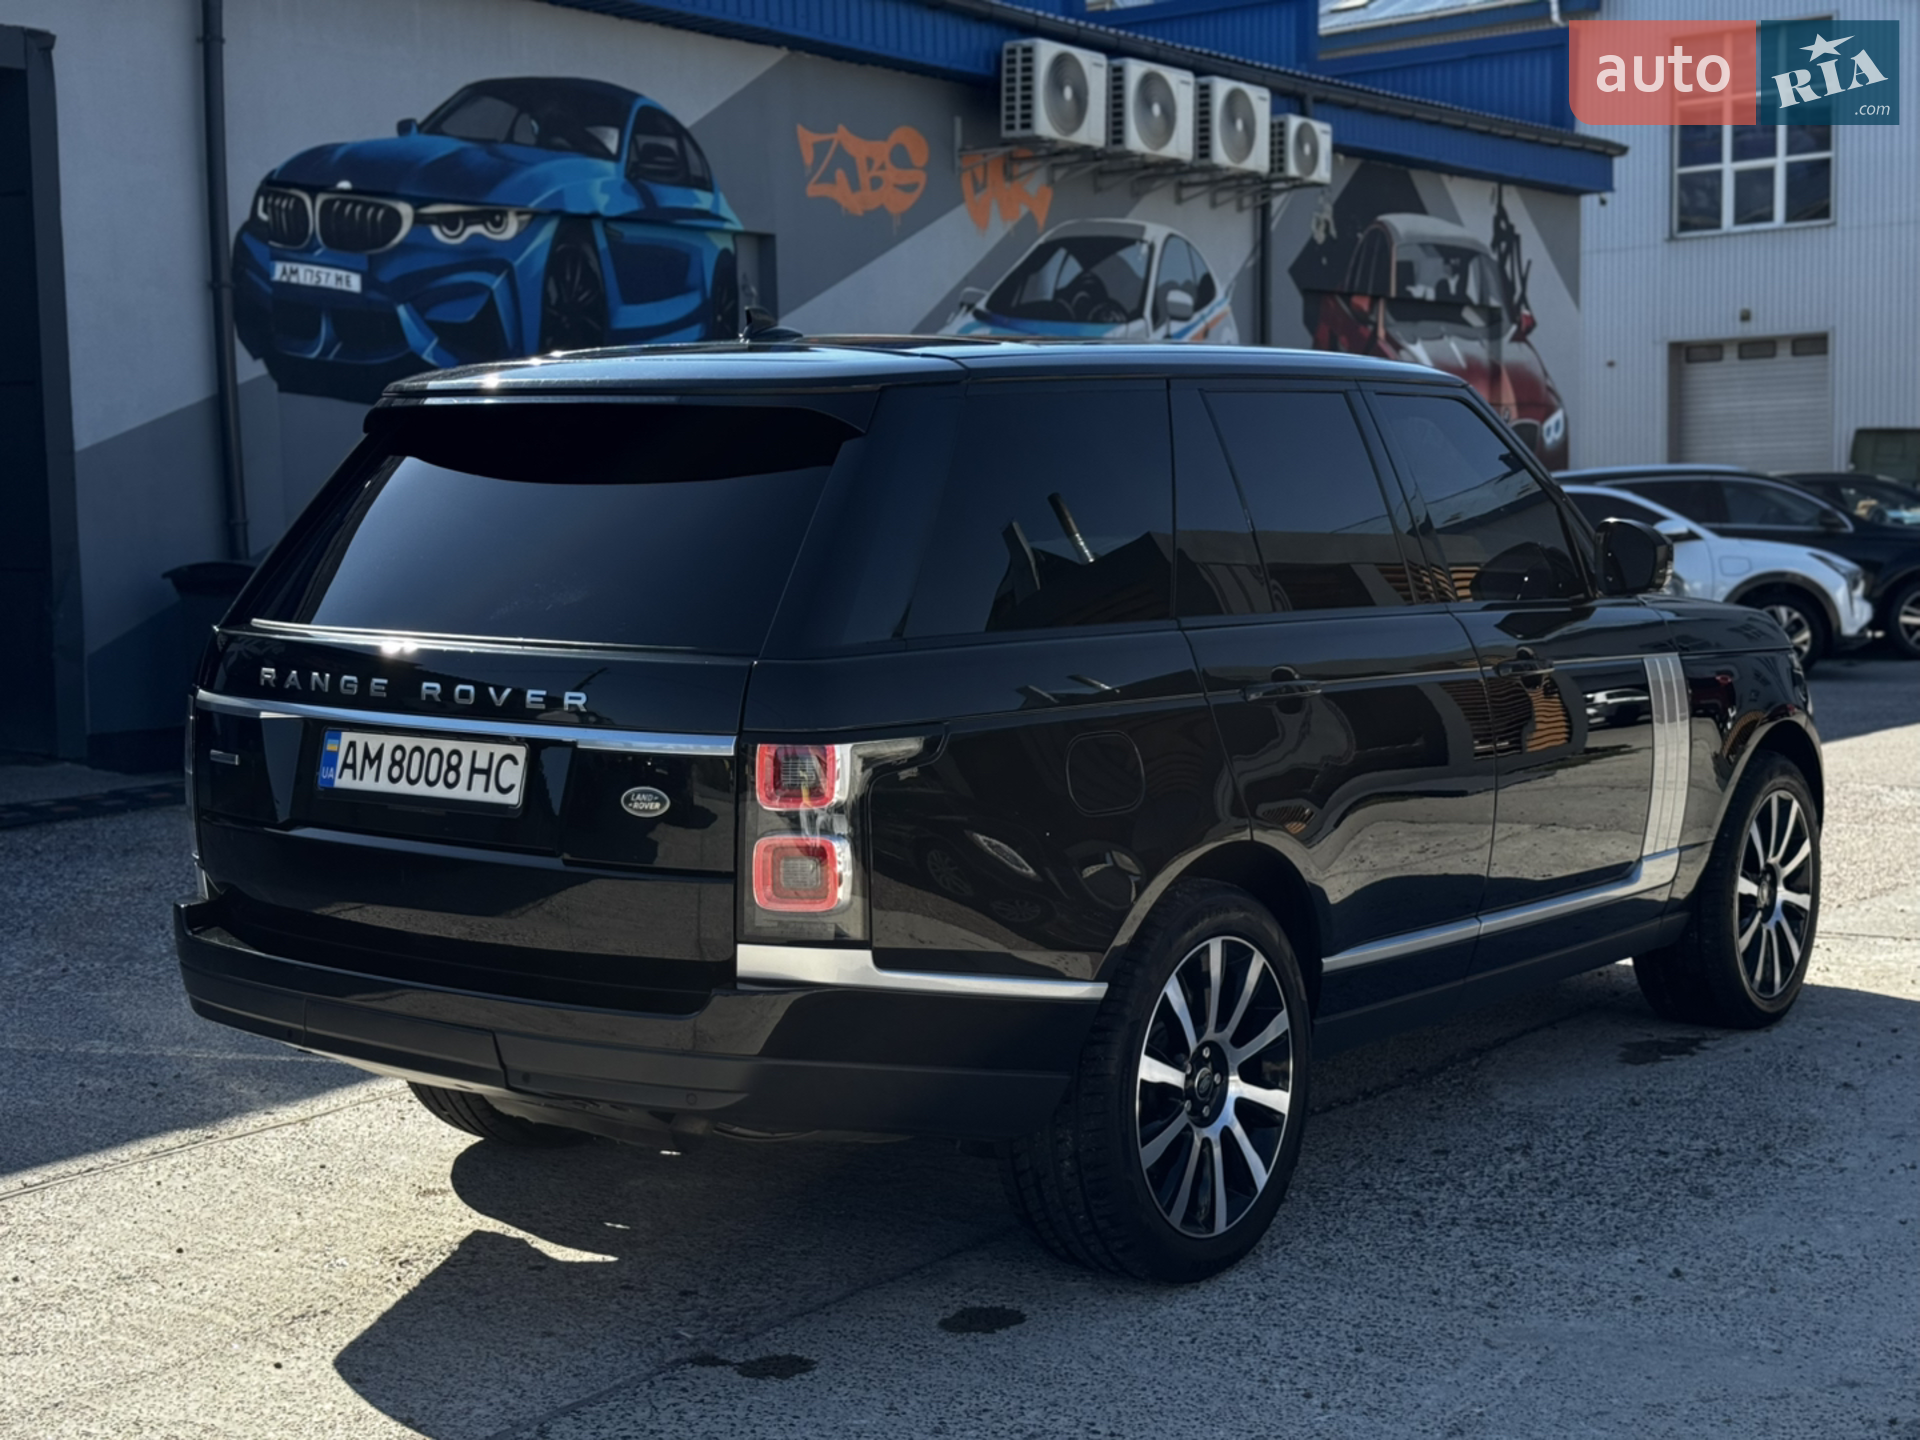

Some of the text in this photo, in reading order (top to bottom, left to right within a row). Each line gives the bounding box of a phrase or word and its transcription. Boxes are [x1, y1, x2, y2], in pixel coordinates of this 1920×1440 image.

[259, 667, 588, 711] RANGE ROVER
[321, 766, 335, 779] UA
[630, 792, 654, 802] LAND
[633, 801, 661, 810] ROVER
